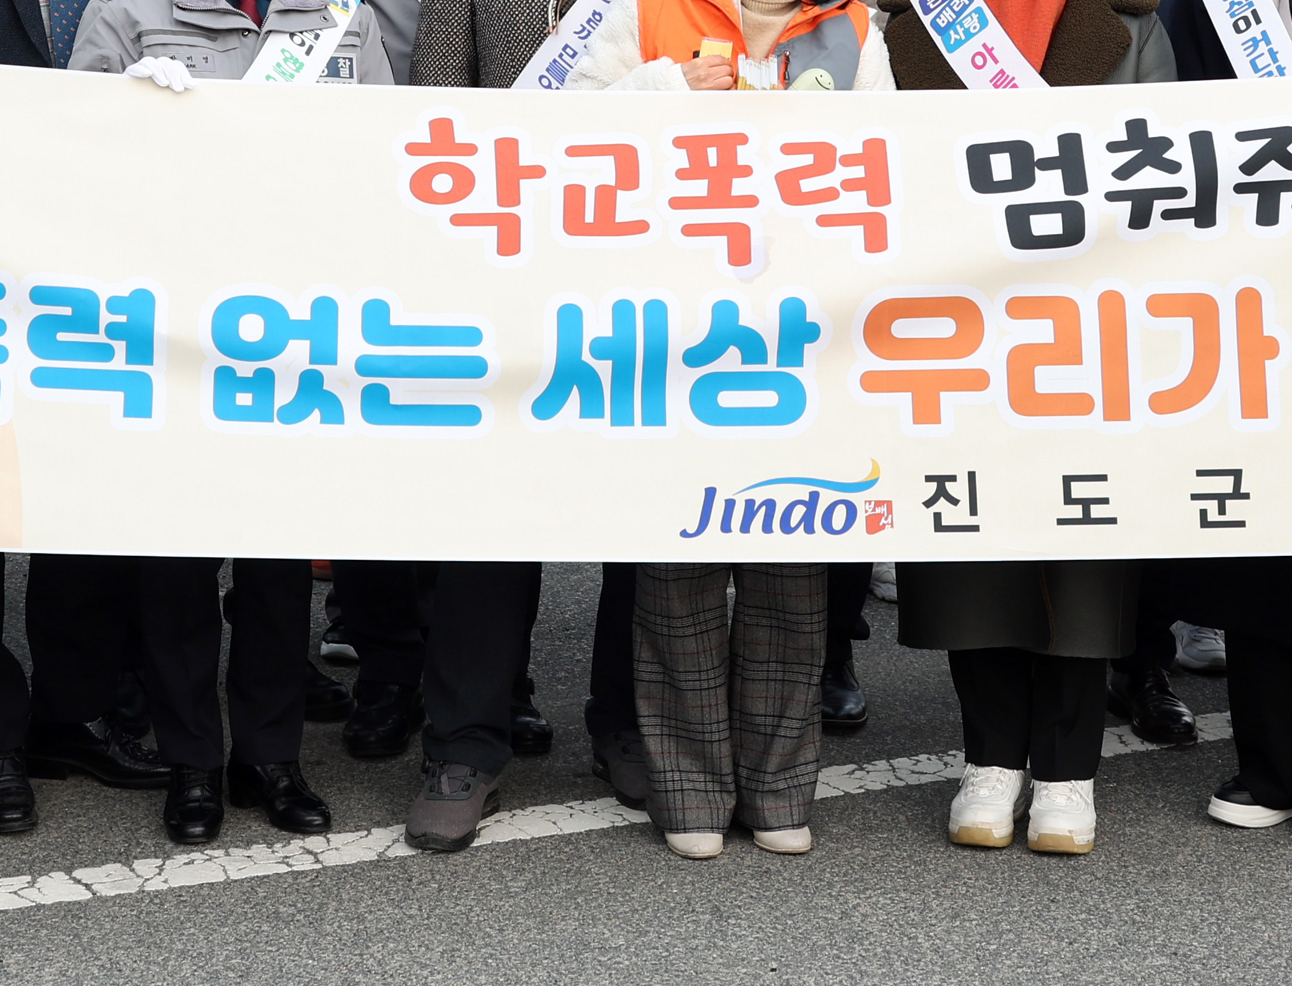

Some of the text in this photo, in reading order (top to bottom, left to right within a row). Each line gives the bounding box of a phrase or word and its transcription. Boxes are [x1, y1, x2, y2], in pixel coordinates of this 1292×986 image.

[949, 12, 981, 46] 사랑
[403, 116, 893, 268] 학교폭력
[210, 293, 490, 429] 없는
[530, 295, 823, 429] 세상
[858, 284, 1281, 425] 우리가
[679, 486, 859, 539] Jindo
